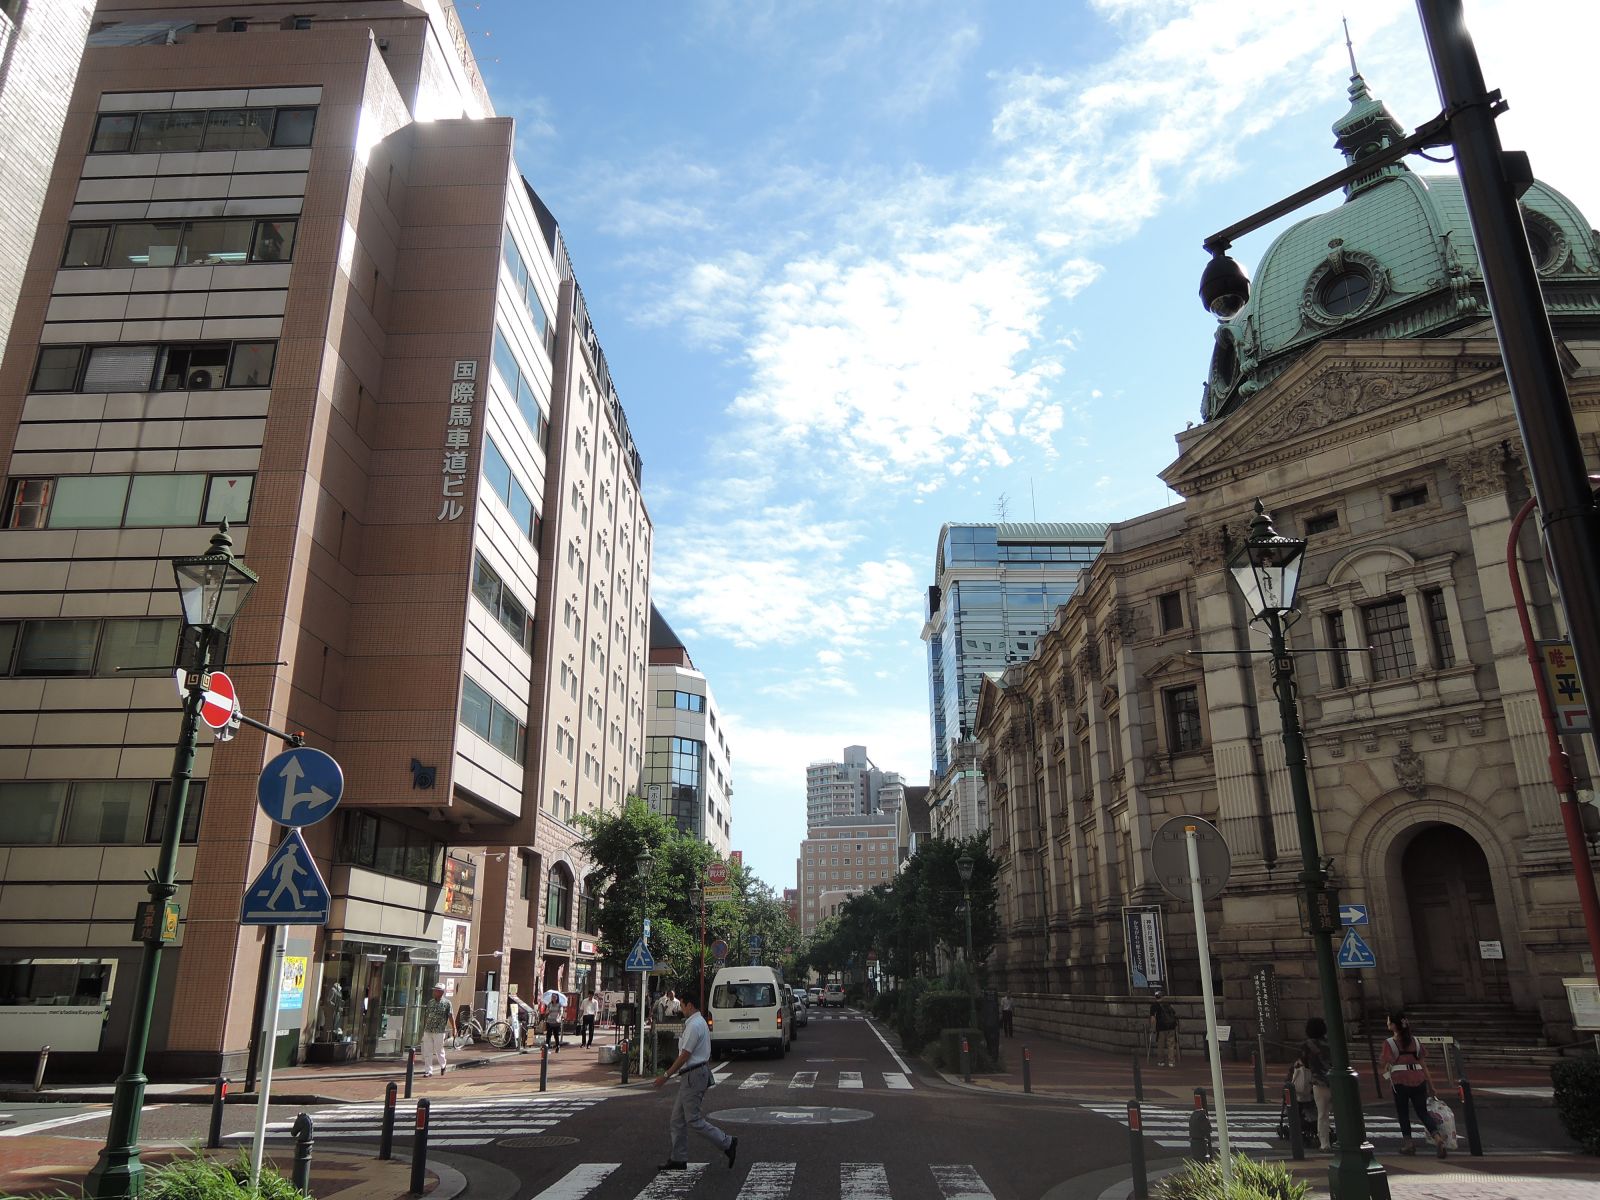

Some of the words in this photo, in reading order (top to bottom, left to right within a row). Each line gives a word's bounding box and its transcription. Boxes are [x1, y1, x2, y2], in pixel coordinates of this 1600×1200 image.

[437, 360, 478, 521] 国際馬車道ビル
[1556, 673, 1581, 701] 平
